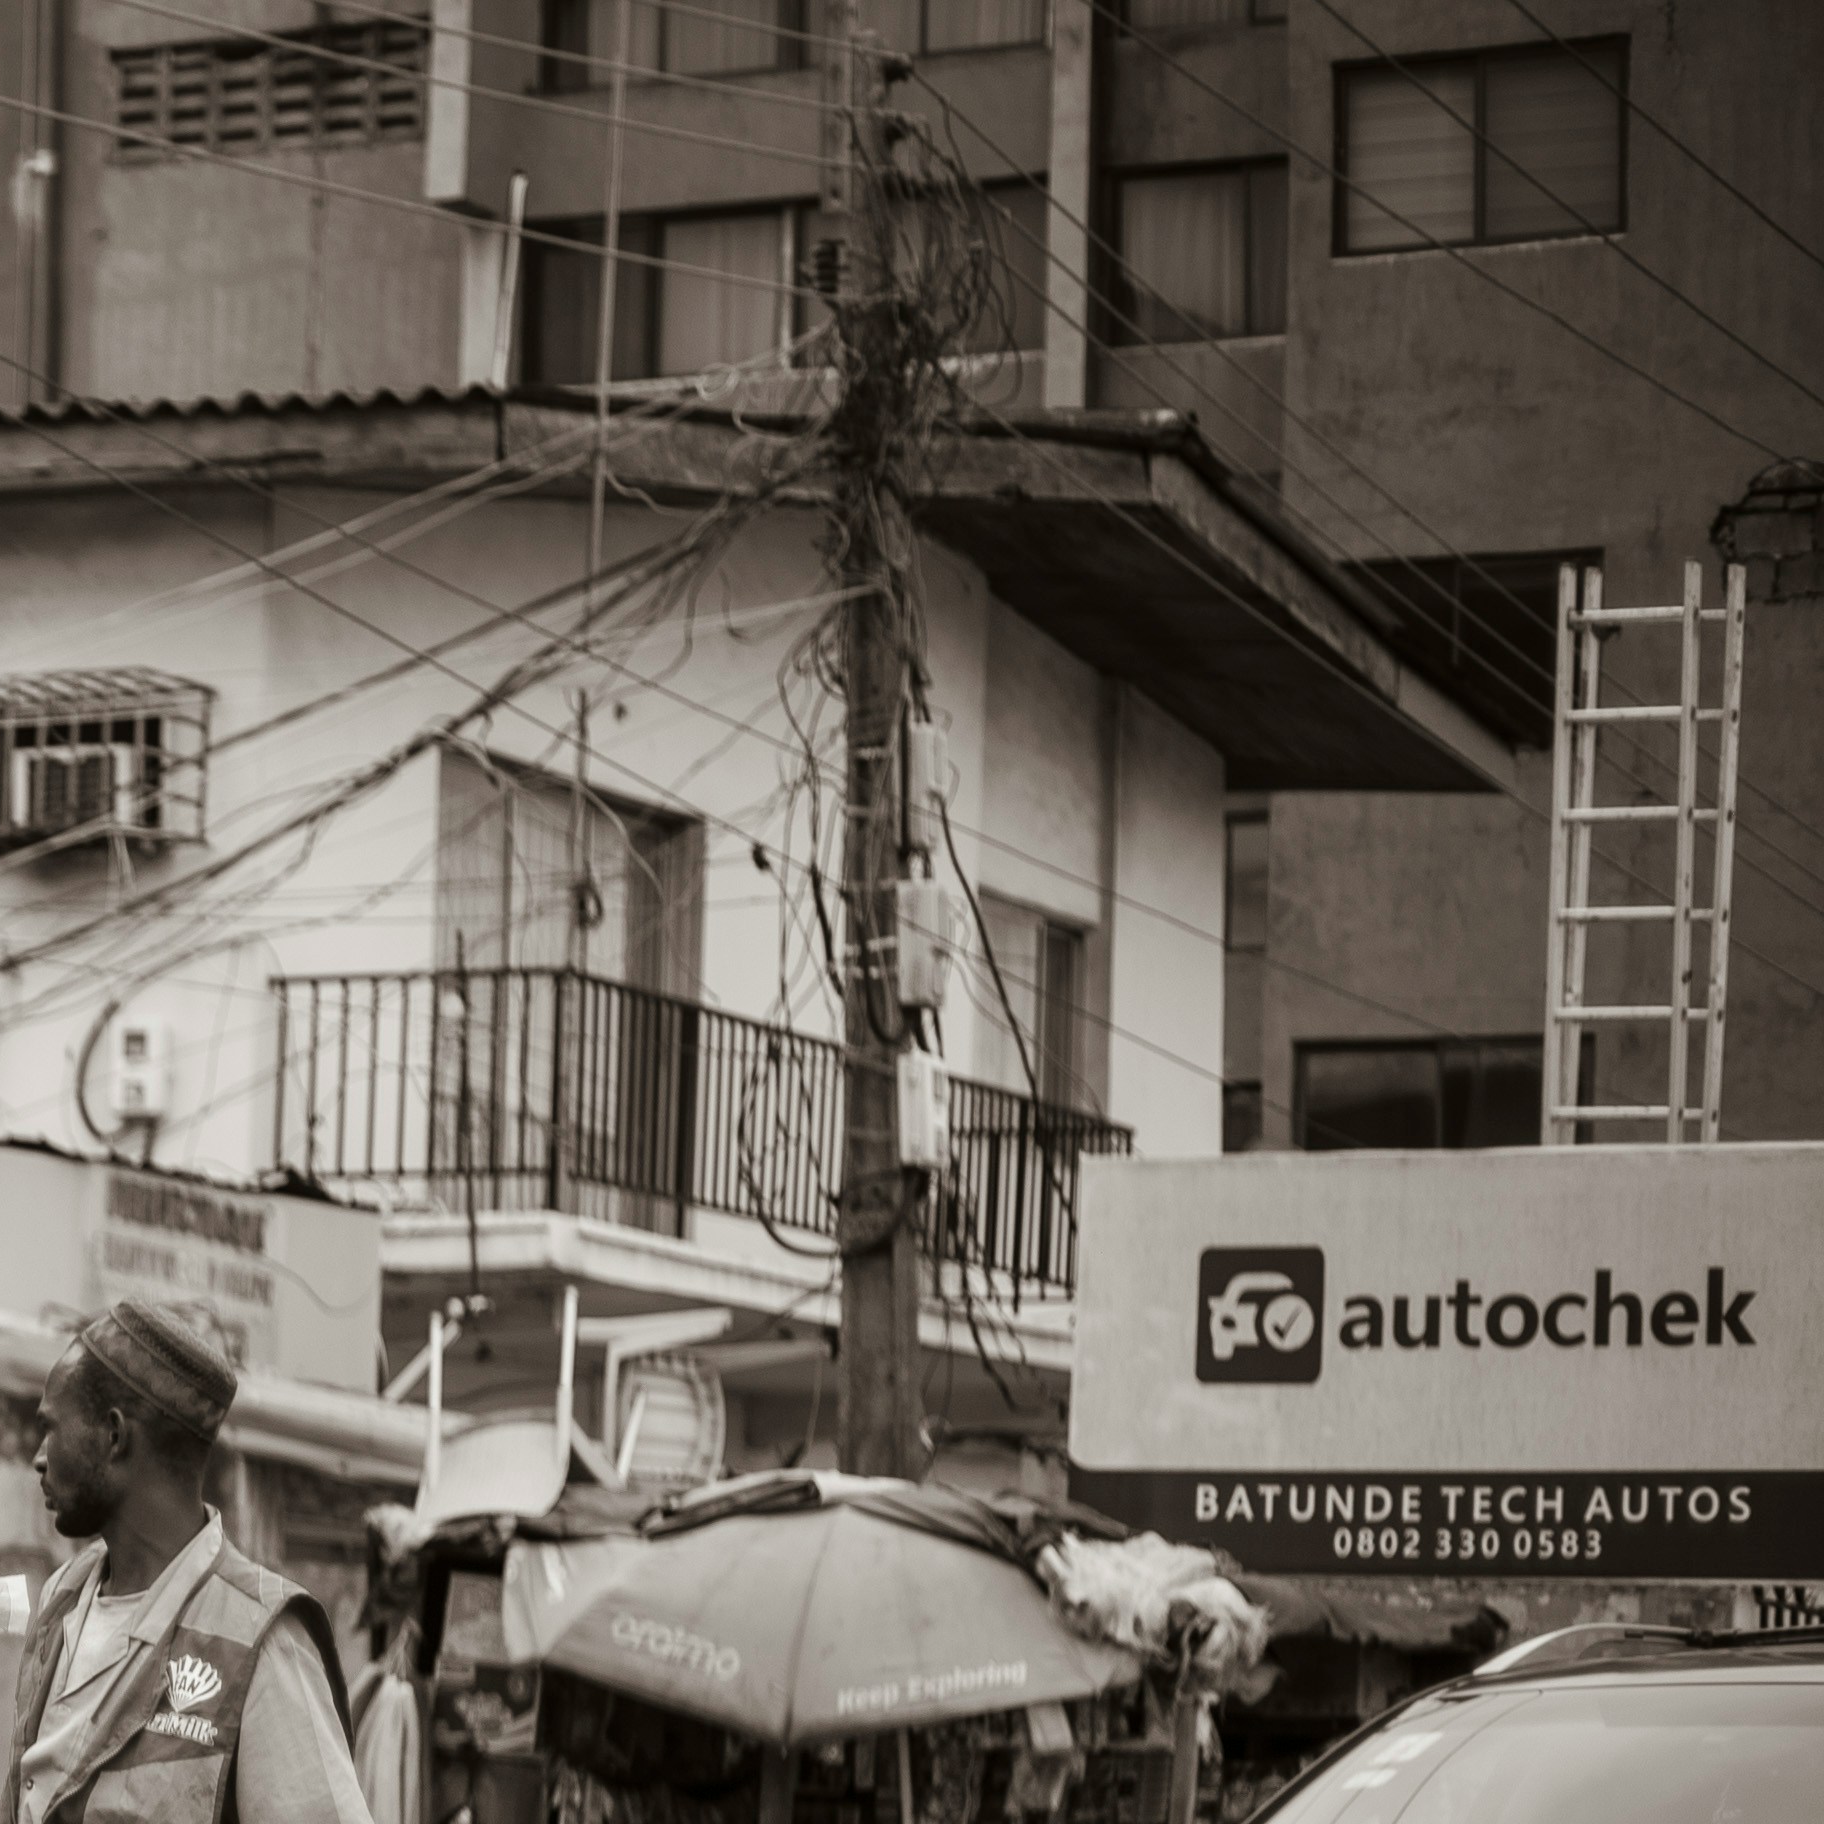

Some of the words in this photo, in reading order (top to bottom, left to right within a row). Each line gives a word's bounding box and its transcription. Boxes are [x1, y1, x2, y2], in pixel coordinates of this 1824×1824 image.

[1338, 1266, 1758, 1350] autochek
[1195, 1482, 1423, 1523] BATUNDE
[1440, 1483, 1566, 1523] TECH
[1583, 1484, 1753, 1524] AUTOS
[1332, 1528, 1422, 1560] 0802
[1434, 1528, 1500, 1560] 330
[1513, 1527, 1604, 1560] 0583
[836, 1682, 899, 1715] Keep
[907, 1661, 1028, 1701] Exploring
